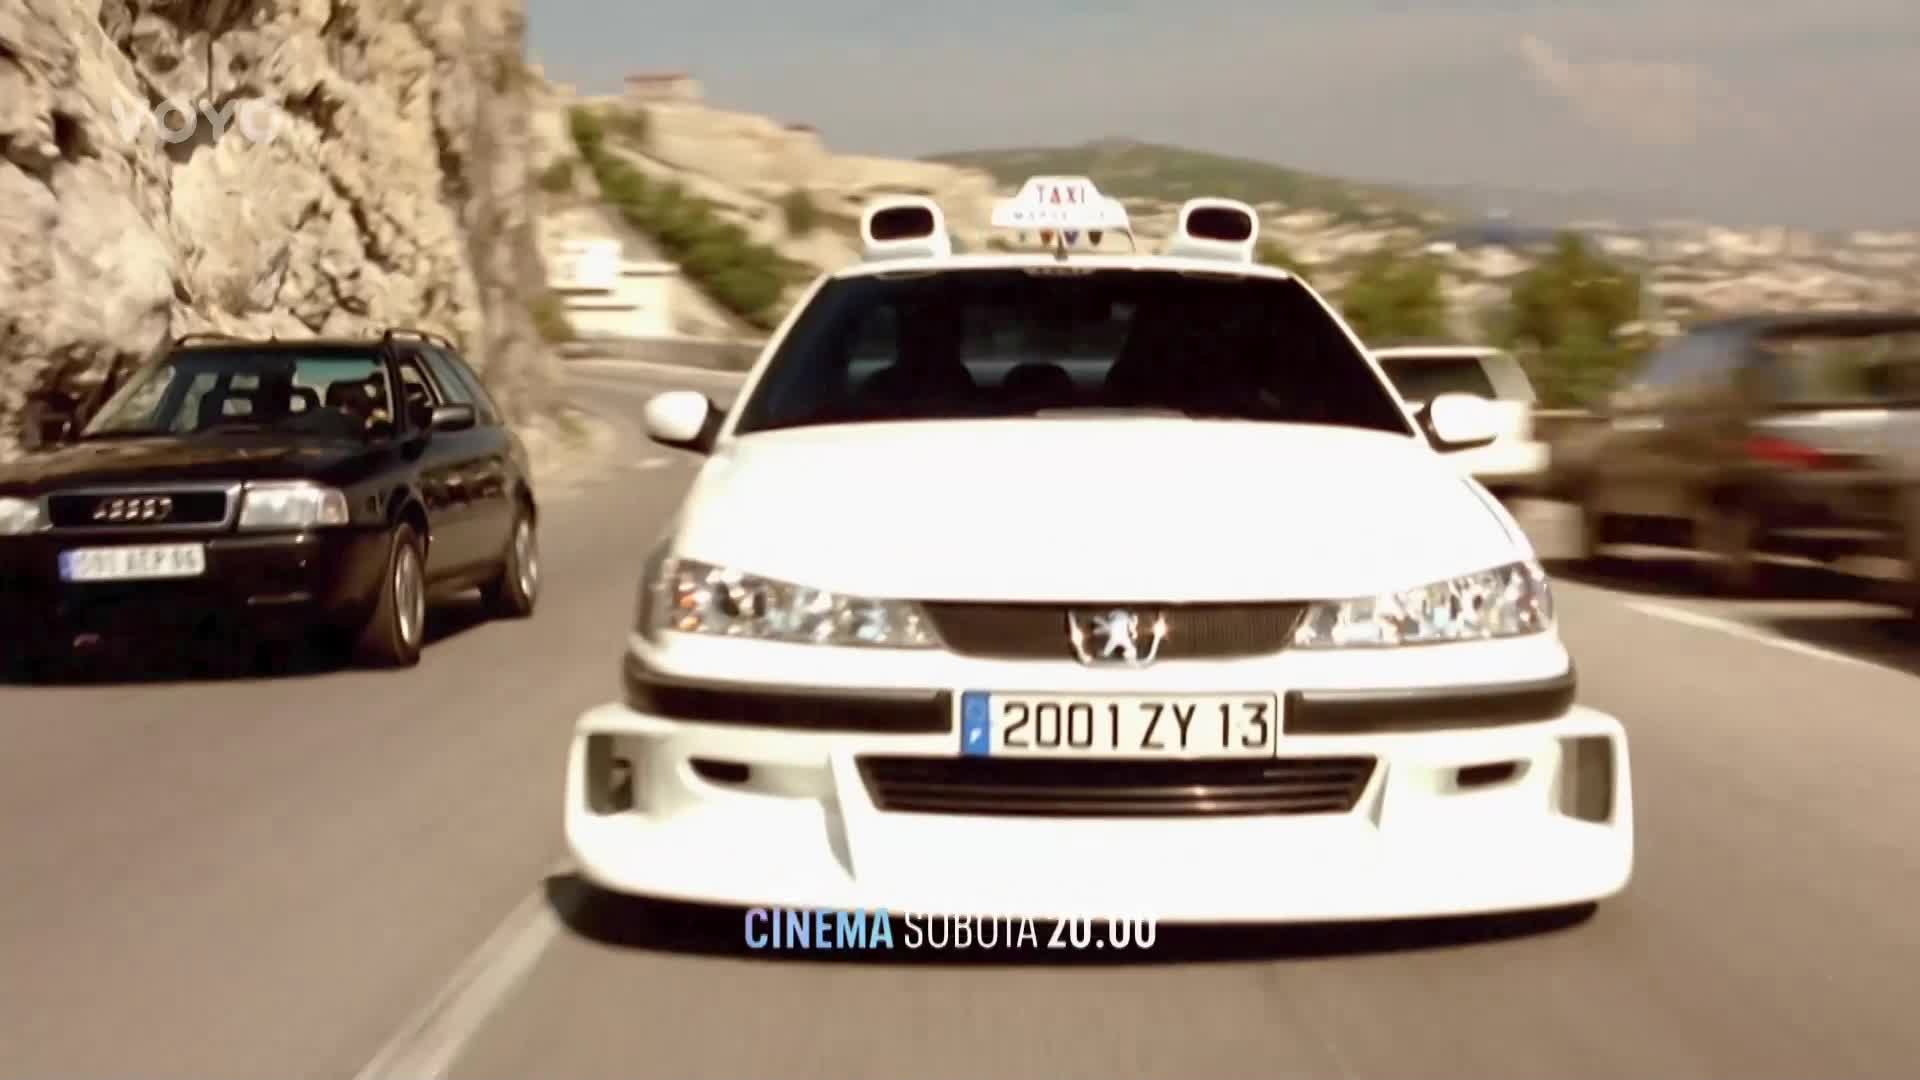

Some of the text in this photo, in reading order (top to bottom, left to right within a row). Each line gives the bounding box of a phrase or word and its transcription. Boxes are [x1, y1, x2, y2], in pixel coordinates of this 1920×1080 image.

[1036, 184, 1086, 204] TAXI
[1003, 702, 1268, 749] 2001 ZY 13
